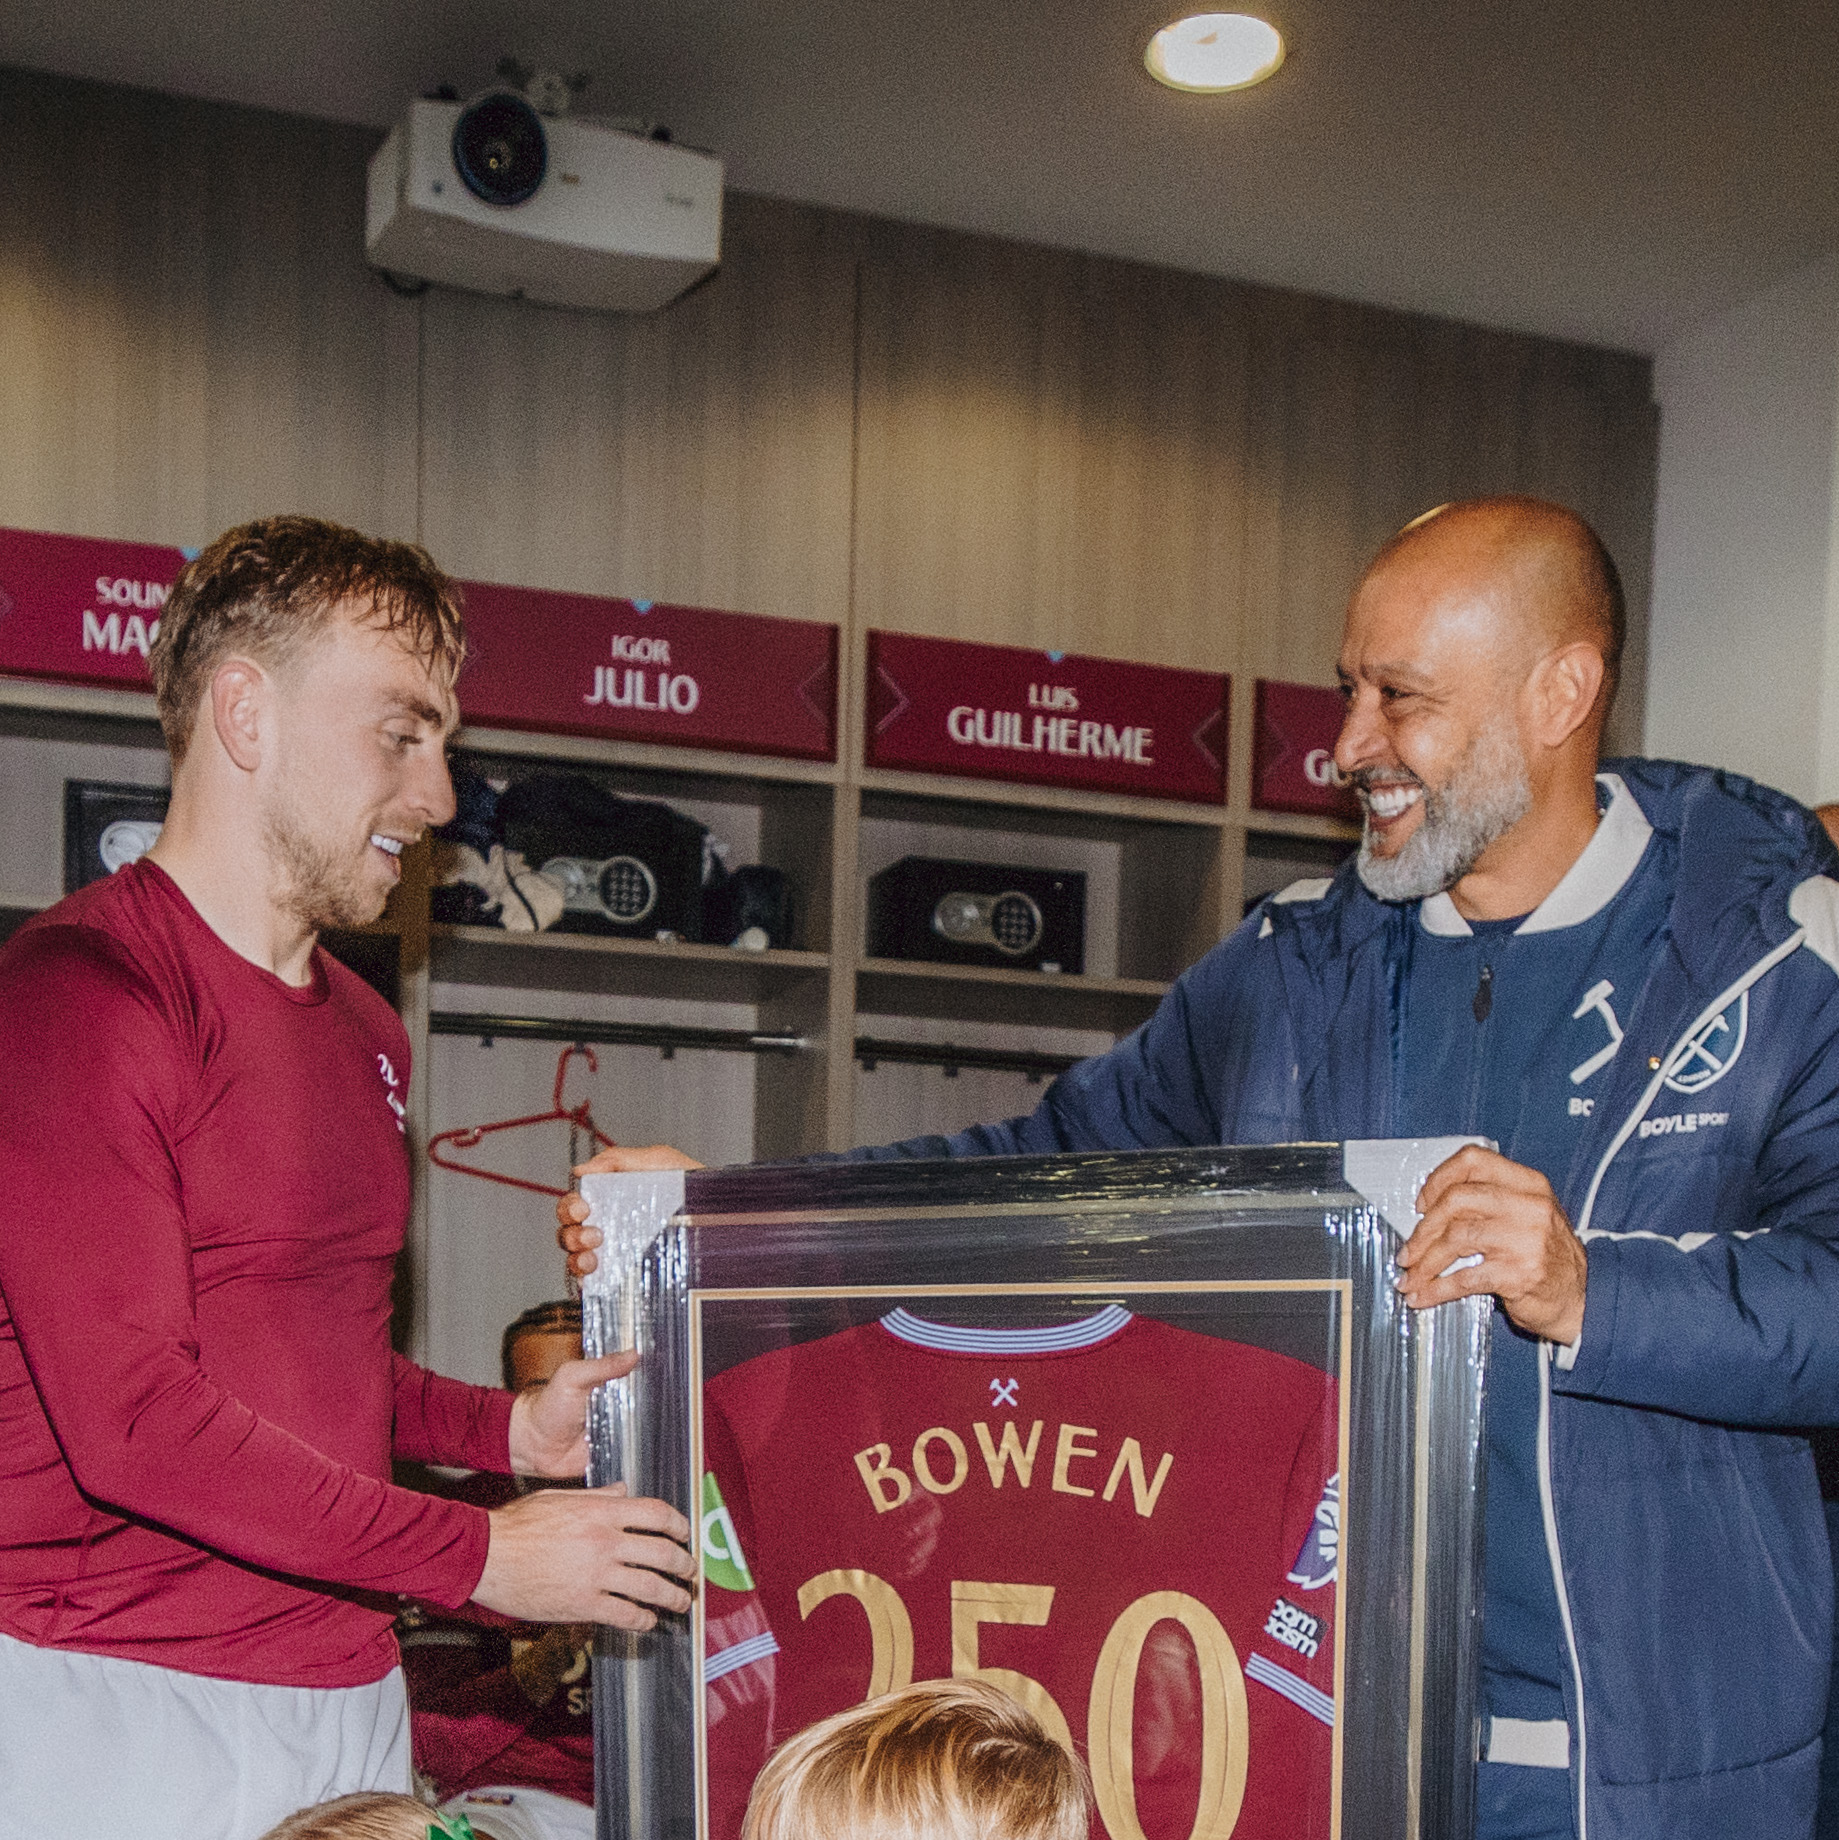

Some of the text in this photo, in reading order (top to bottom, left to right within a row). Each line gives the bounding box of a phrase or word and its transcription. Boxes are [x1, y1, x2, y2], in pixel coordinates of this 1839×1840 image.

[611, 634, 672, 665] IGOR
[583, 664, 700, 715] JULIO
[1028, 683, 1079, 712] LUIS
[947, 706, 1154, 764] GUILHERME
[1639, 1112, 1729, 1138] BOYLE SPORT
[853, 1419, 1175, 1520] BOWEN
